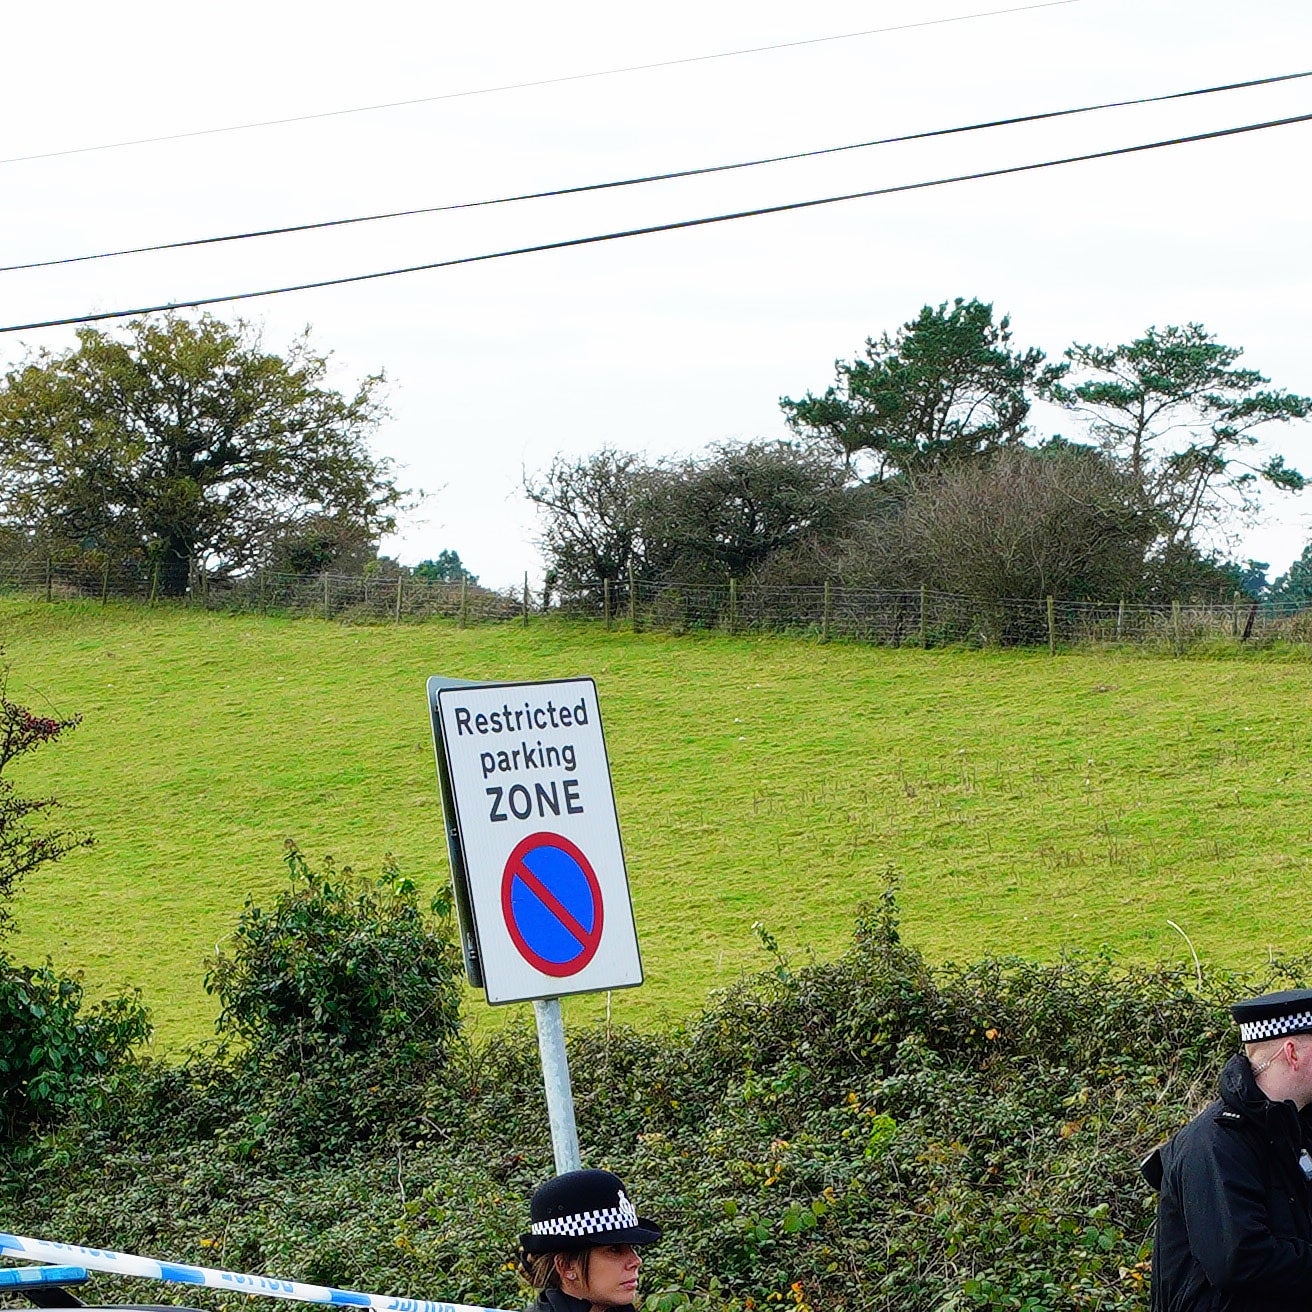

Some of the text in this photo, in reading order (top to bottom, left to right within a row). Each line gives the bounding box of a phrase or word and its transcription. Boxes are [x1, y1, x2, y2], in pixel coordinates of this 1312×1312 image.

[454, 697, 589, 736] Restricted
[480, 740, 577, 779] parking
[485, 779, 585, 822] ZONE
